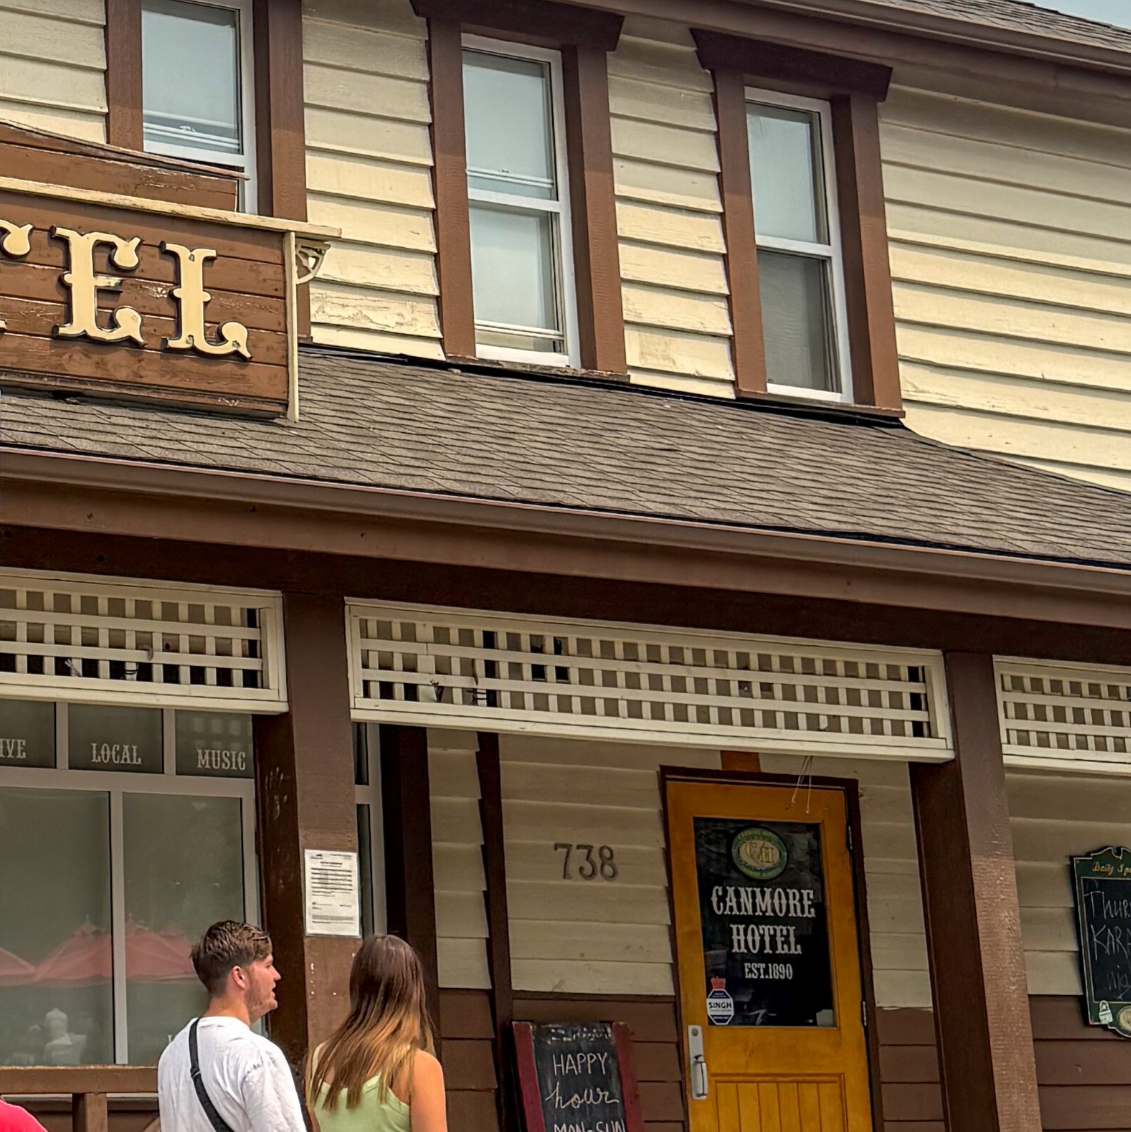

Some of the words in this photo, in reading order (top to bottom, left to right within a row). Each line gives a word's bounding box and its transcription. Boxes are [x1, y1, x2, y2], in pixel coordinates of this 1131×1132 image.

[91, 743, 142, 765] LOCAL
[196, 748, 246, 771] MUSIC
[554, 842, 618, 882] 738
[710, 885, 816, 918] CANMORE
[729, 924, 803, 955] HOTEL
[744, 962, 794, 980] EST.1890
[708, 1001, 732, 1009] SINGH
[552, 1052, 608, 1076] HAPPY
[545, 1081, 620, 1109] hour
